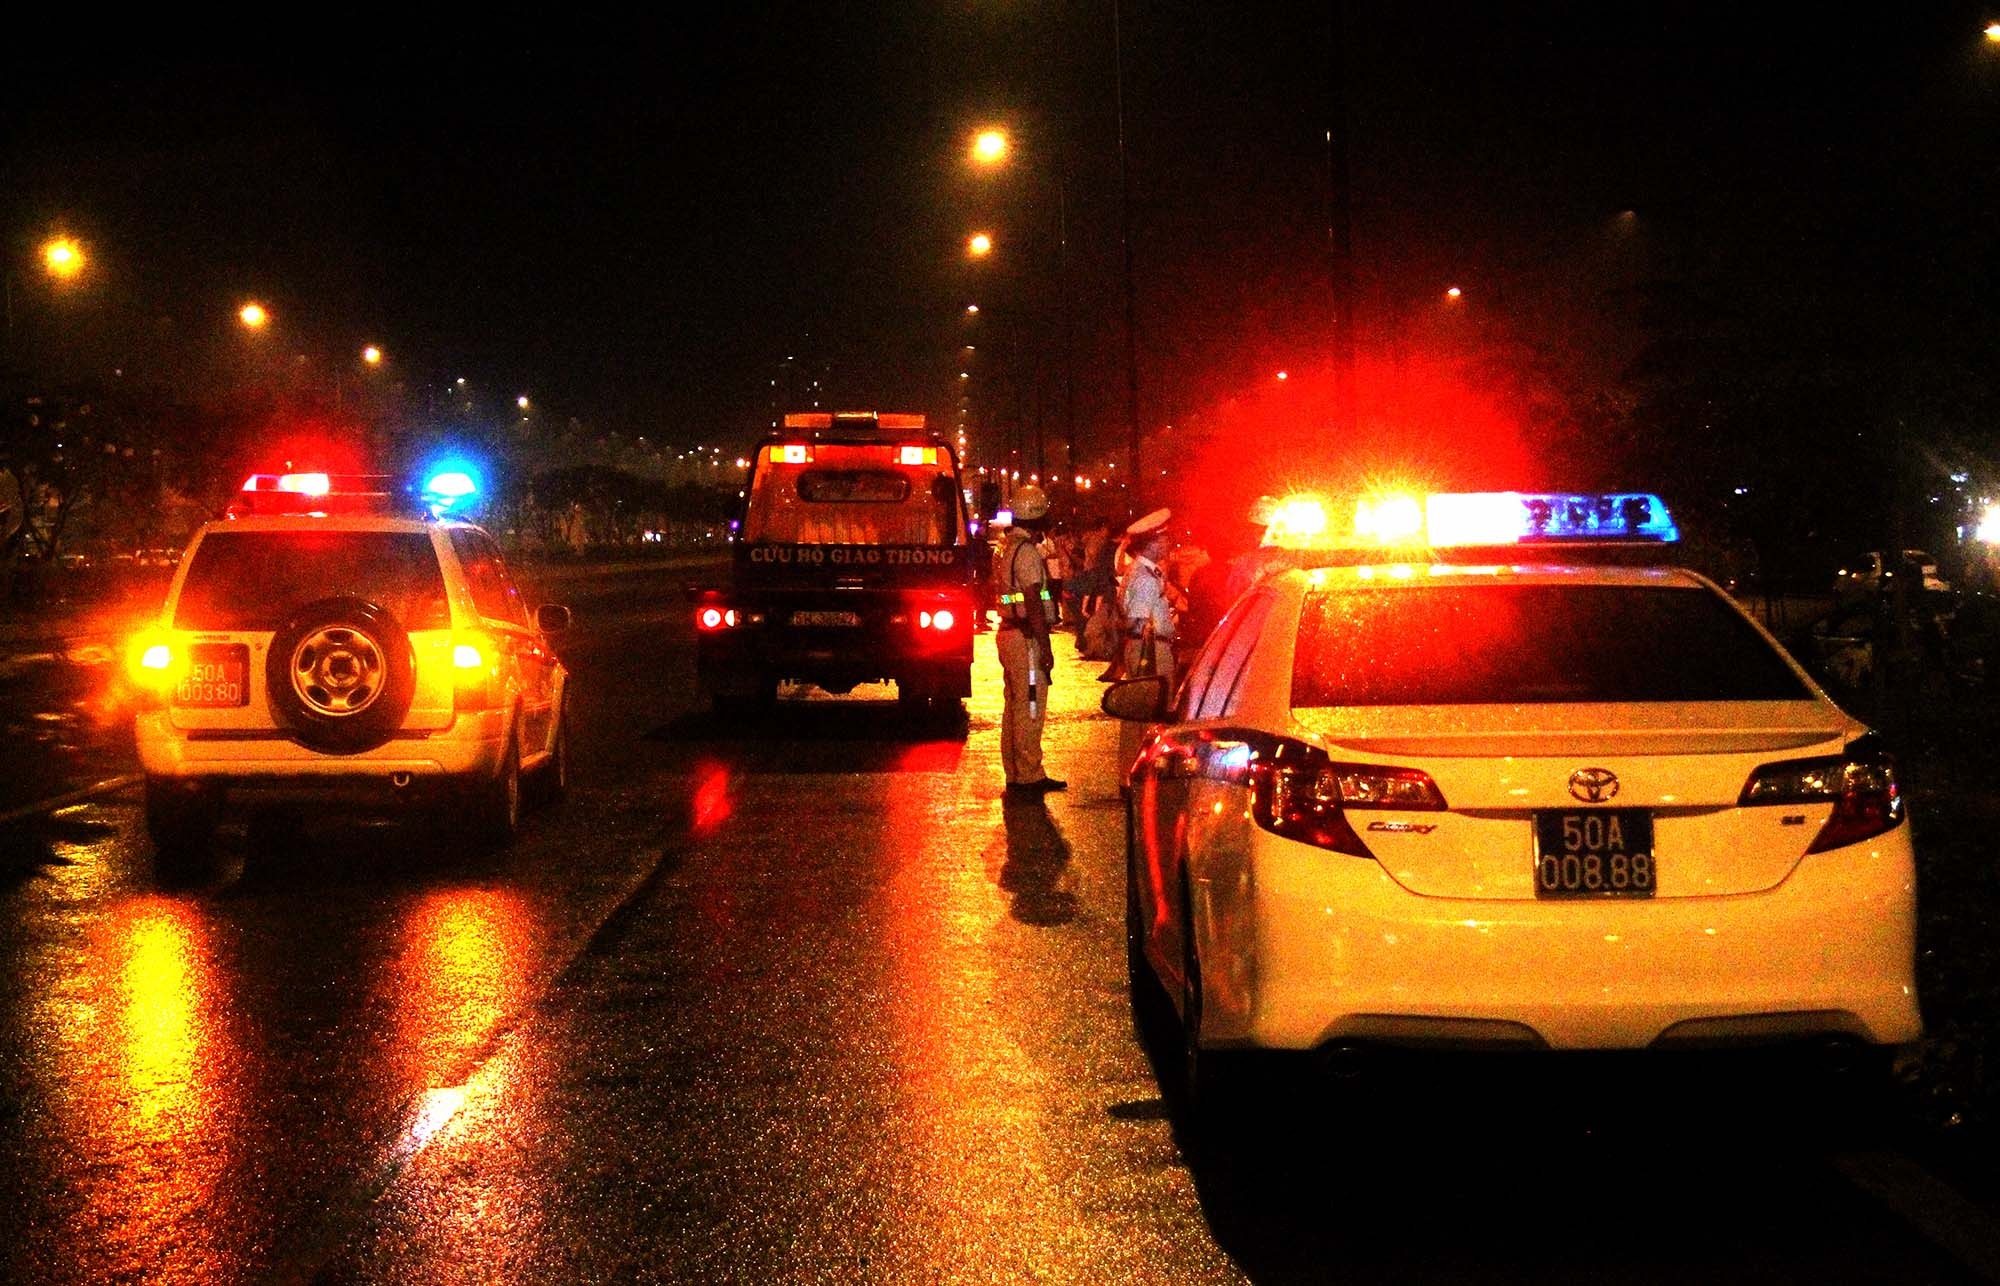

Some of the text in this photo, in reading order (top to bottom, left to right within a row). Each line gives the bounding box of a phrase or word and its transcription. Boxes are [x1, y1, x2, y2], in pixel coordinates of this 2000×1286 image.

[831, 548, 880, 563] GIAO
[886, 547, 955, 564] THÔNG
[193, 664, 226, 682] 50A
[1563, 815, 1625, 851] 50A
